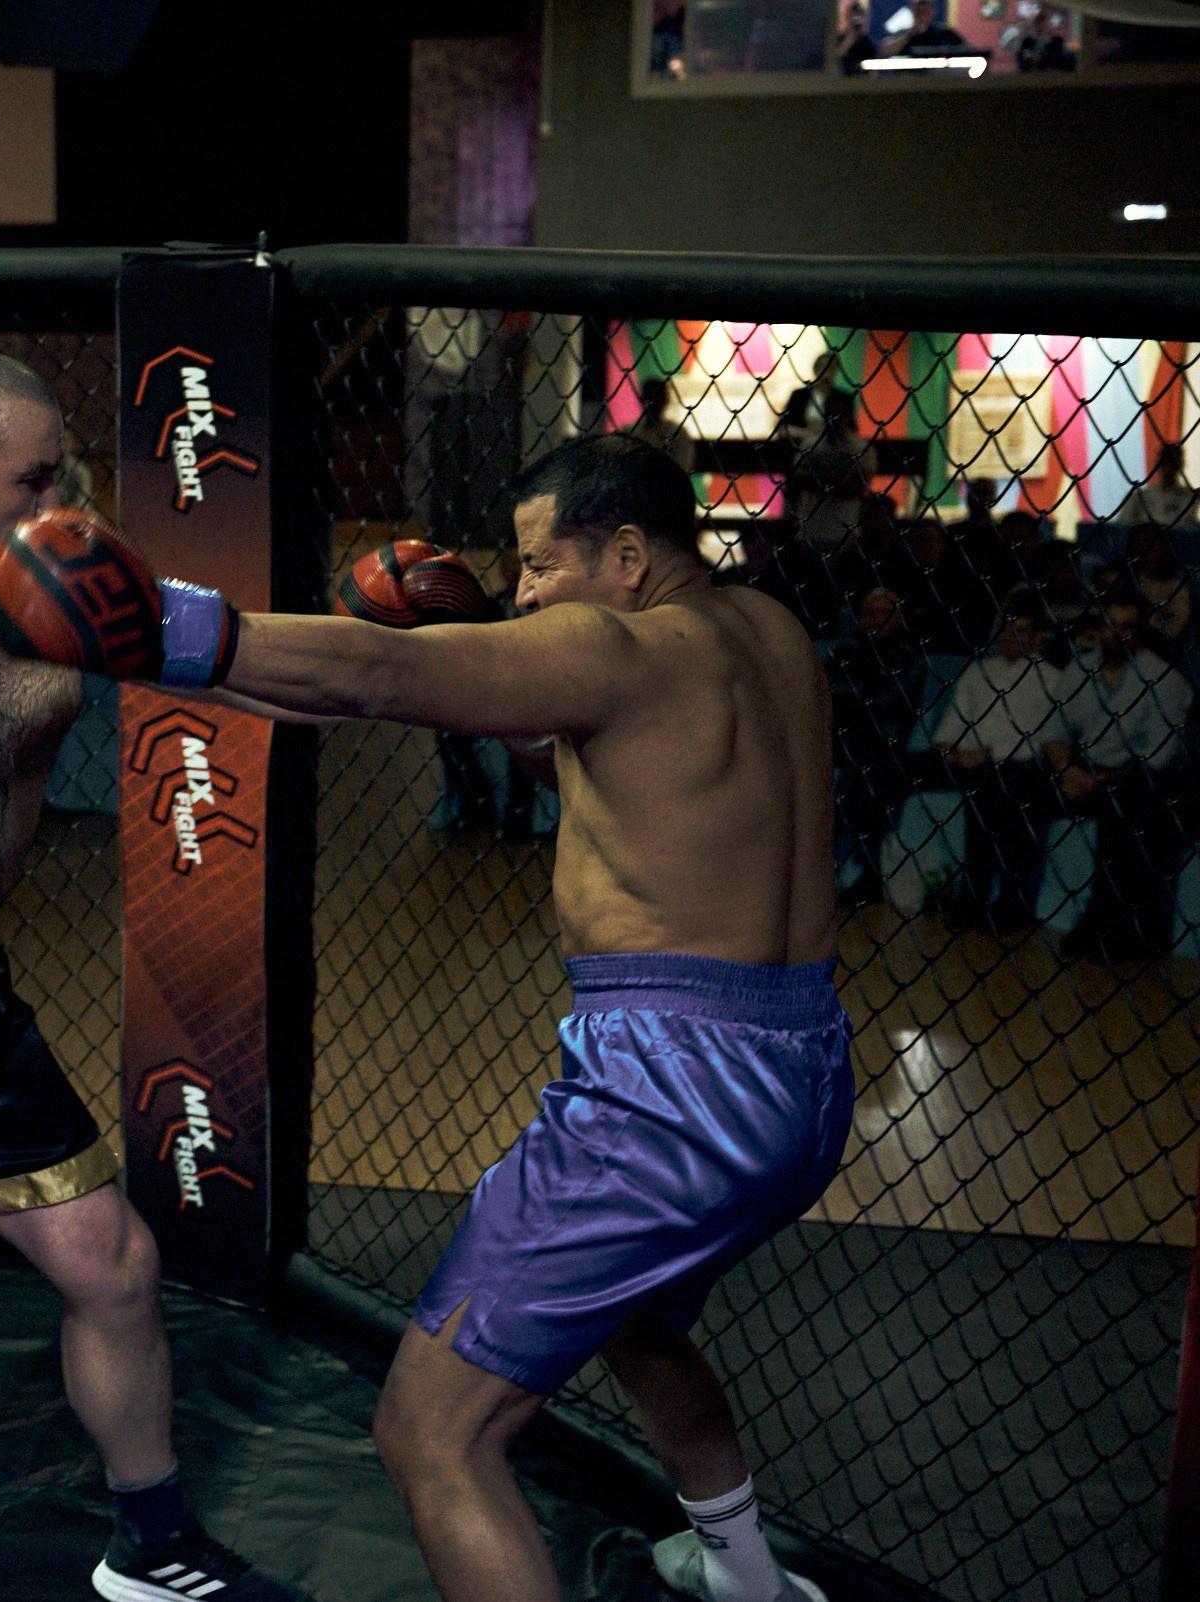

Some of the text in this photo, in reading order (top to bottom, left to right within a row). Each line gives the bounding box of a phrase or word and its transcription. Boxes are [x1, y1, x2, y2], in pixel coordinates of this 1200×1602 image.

[174, 366, 217, 501] MIX FIGHT
[174, 737, 215, 865] MIX FIGHT
[176, 1085, 215, 1207] MIX FIGHT
